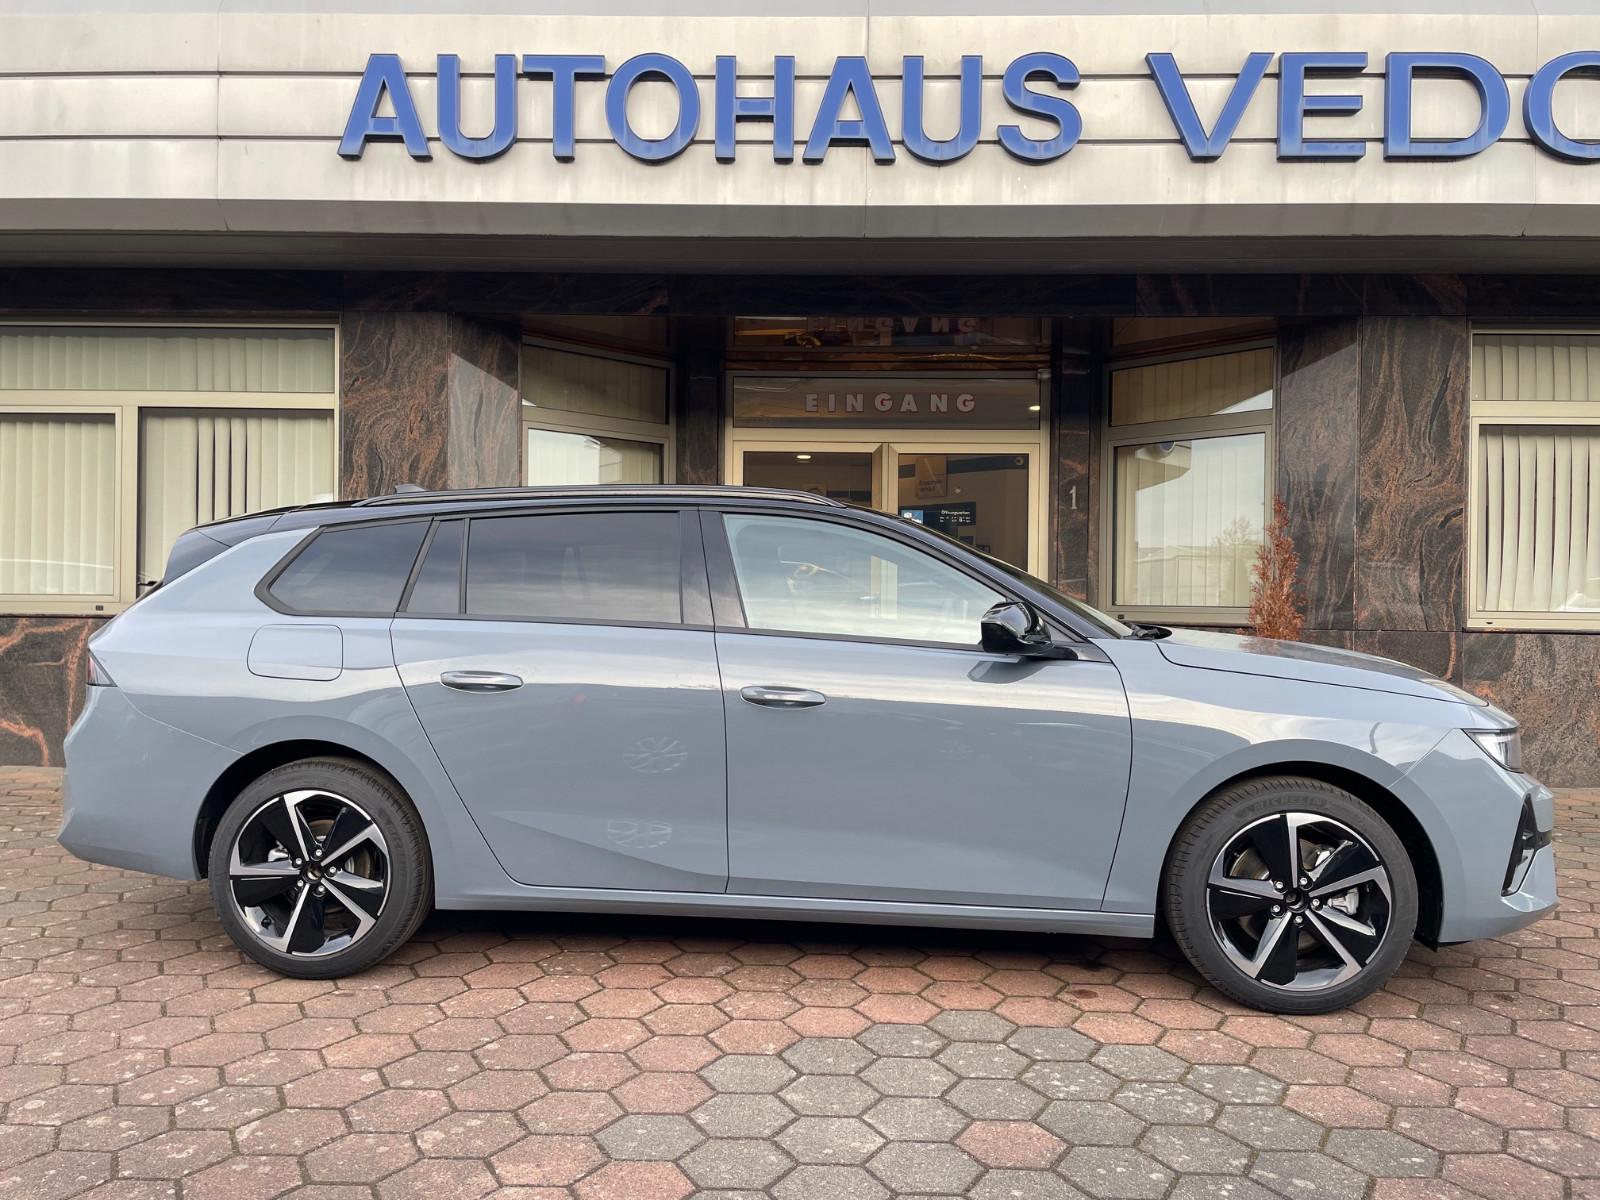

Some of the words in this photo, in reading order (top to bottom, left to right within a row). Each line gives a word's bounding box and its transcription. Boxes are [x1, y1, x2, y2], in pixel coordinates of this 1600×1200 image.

[338, 52, 1082, 164] AUTOHAUS
[805, 392, 977, 413] EINGANG
[1069, 485, 1077, 510] 1
